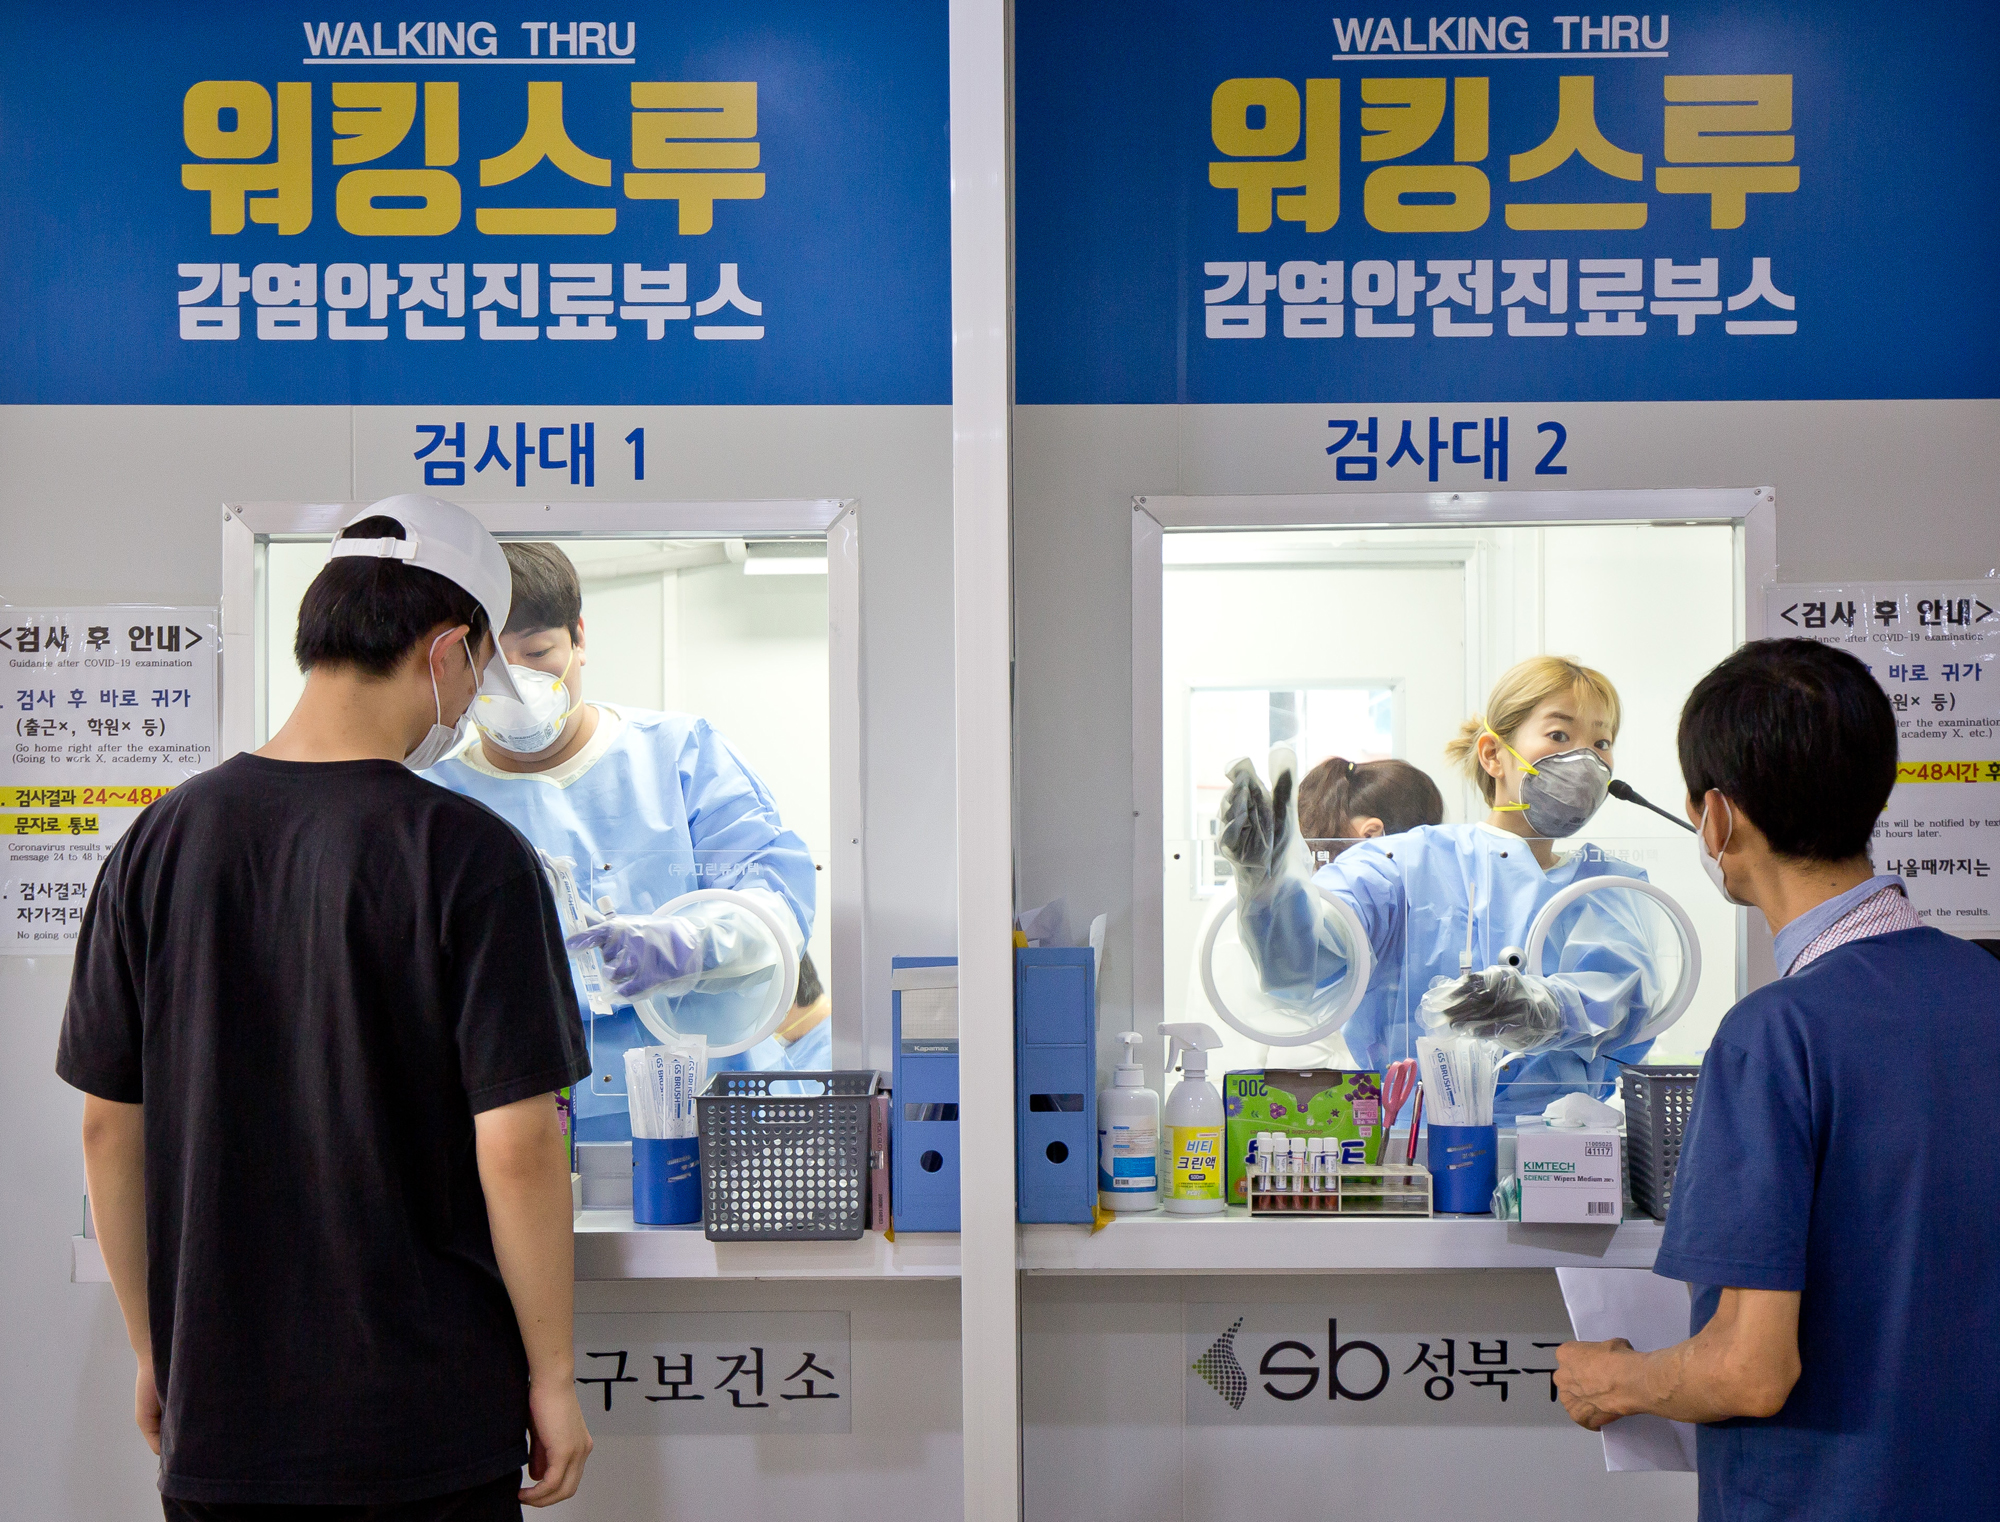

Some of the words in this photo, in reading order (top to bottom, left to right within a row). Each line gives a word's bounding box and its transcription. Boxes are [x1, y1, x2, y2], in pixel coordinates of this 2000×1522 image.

[304, 21, 498, 57] WALKING
[521, 21, 637, 57] THRU
[1332, 17, 1529, 53] WALKING
[1560, 15, 1670, 51] THRU
[181, 80, 766, 236] 워킹스루
[1209, 74, 1801, 233] 워킹스루
[177, 262, 765, 341] 감염안전진료부스
[1203, 257, 1798, 339] 감염안전진료부스
[413, 422, 597, 488] 검사대
[624, 427, 646, 481] 1
[1325, 416, 1510, 483] 검사대
[1534, 421, 1569, 476] 2
[1780, 601, 1857, 628] <검사
[1874, 600, 1899, 627] 후
[1917, 599, 1994, 626] 안내>
[0, 625, 69, 652] <검사
[86, 625, 110, 652] 후
[128, 625, 203, 652] 안내>
[1845, 634, 1868, 643] after
[1872, 634, 1920, 643] COVID-19
[1925, 633, 1984, 642] examination
[9, 659, 53, 668] Guidance
[57, 659, 80, 668] after
[84, 659, 131, 668] COVID-19
[135, 659, 193, 667] examination
[1889, 663, 1929, 683] 바로
[1941, 662, 1983, 682] 귀가
[16, 689, 56, 711] 검사
[67, 688, 87, 709] 후
[100, 689, 139, 708] 바로
[151, 688, 191, 708] 귀가
[1931, 692, 1956, 712] 등)
[141, 717, 166, 737] 등)
[1916, 718, 1933, 728] the
[1938, 717, 2000, 727] examination
[1901, 729, 1948, 739] academy
[1969, 728, 1993, 739] etc.)
[15, 744, 29, 753] Go
[34, 743, 62, 753] home
[68, 743, 92, 754] right
[97, 743, 123, 753] after
[127, 743, 143, 753] the
[148, 744, 211, 753] examination
[12, 754, 45, 764] (Going
[50, 754, 61, 763] to
[66, 754, 91, 763] work
[111, 754, 157, 764] academy
[178, 753, 202, 764] etc.)
[15, 789, 76, 808] 검사결과
[14, 817, 61, 835] 문자로
[68, 817, 99, 835] 통보
[1894, 819, 1909, 828] will
[1913, 819, 1925, 828] be
[1929, 819, 1965, 828] notified
[1969, 818, 1980, 828] by
[1885, 829, 1913, 838] hours
[1917, 829, 1942, 838] later.
[8, 843, 66, 851] Coronavirus
[69, 843, 101, 851] results
[10, 854, 49, 862] message
[53, 853, 64, 861] 24
[68, 853, 78, 861] to
[82, 853, 92, 861] 48
[1887, 858, 1991, 878] 나올때까지는
[20, 882, 87, 901] 검사결과
[17, 907, 83, 926] 자가격리
[1918, 908, 1932, 917] get
[1936, 908, 1952, 916] the
[1956, 907, 1991, 917] results.
[17, 931, 30, 939] No
[34, 930, 59, 940] going
[63, 931, 78, 939] out
[656, 1057, 663, 1069] GS
[1437, 1052, 1446, 1063] GS
[674, 1063, 682, 1075] GS
[1440, 1064, 1452, 1091] BRUSH
[674, 1076, 682, 1102] BRUSH
[1186, 1140, 1213, 1154] 비티
[1587, 1147, 1611, 1155] 41117
[1177, 1156, 1217, 1170] 크린액
[1523, 1161, 1576, 1171] KIMTECH
[1523, 1174, 1550, 1182] SCIENCE
[1553, 1175, 1576, 1183] Wipers
[1259, 1318, 1391, 1402] sb
[575, 1347, 840, 1412] 구보건소
